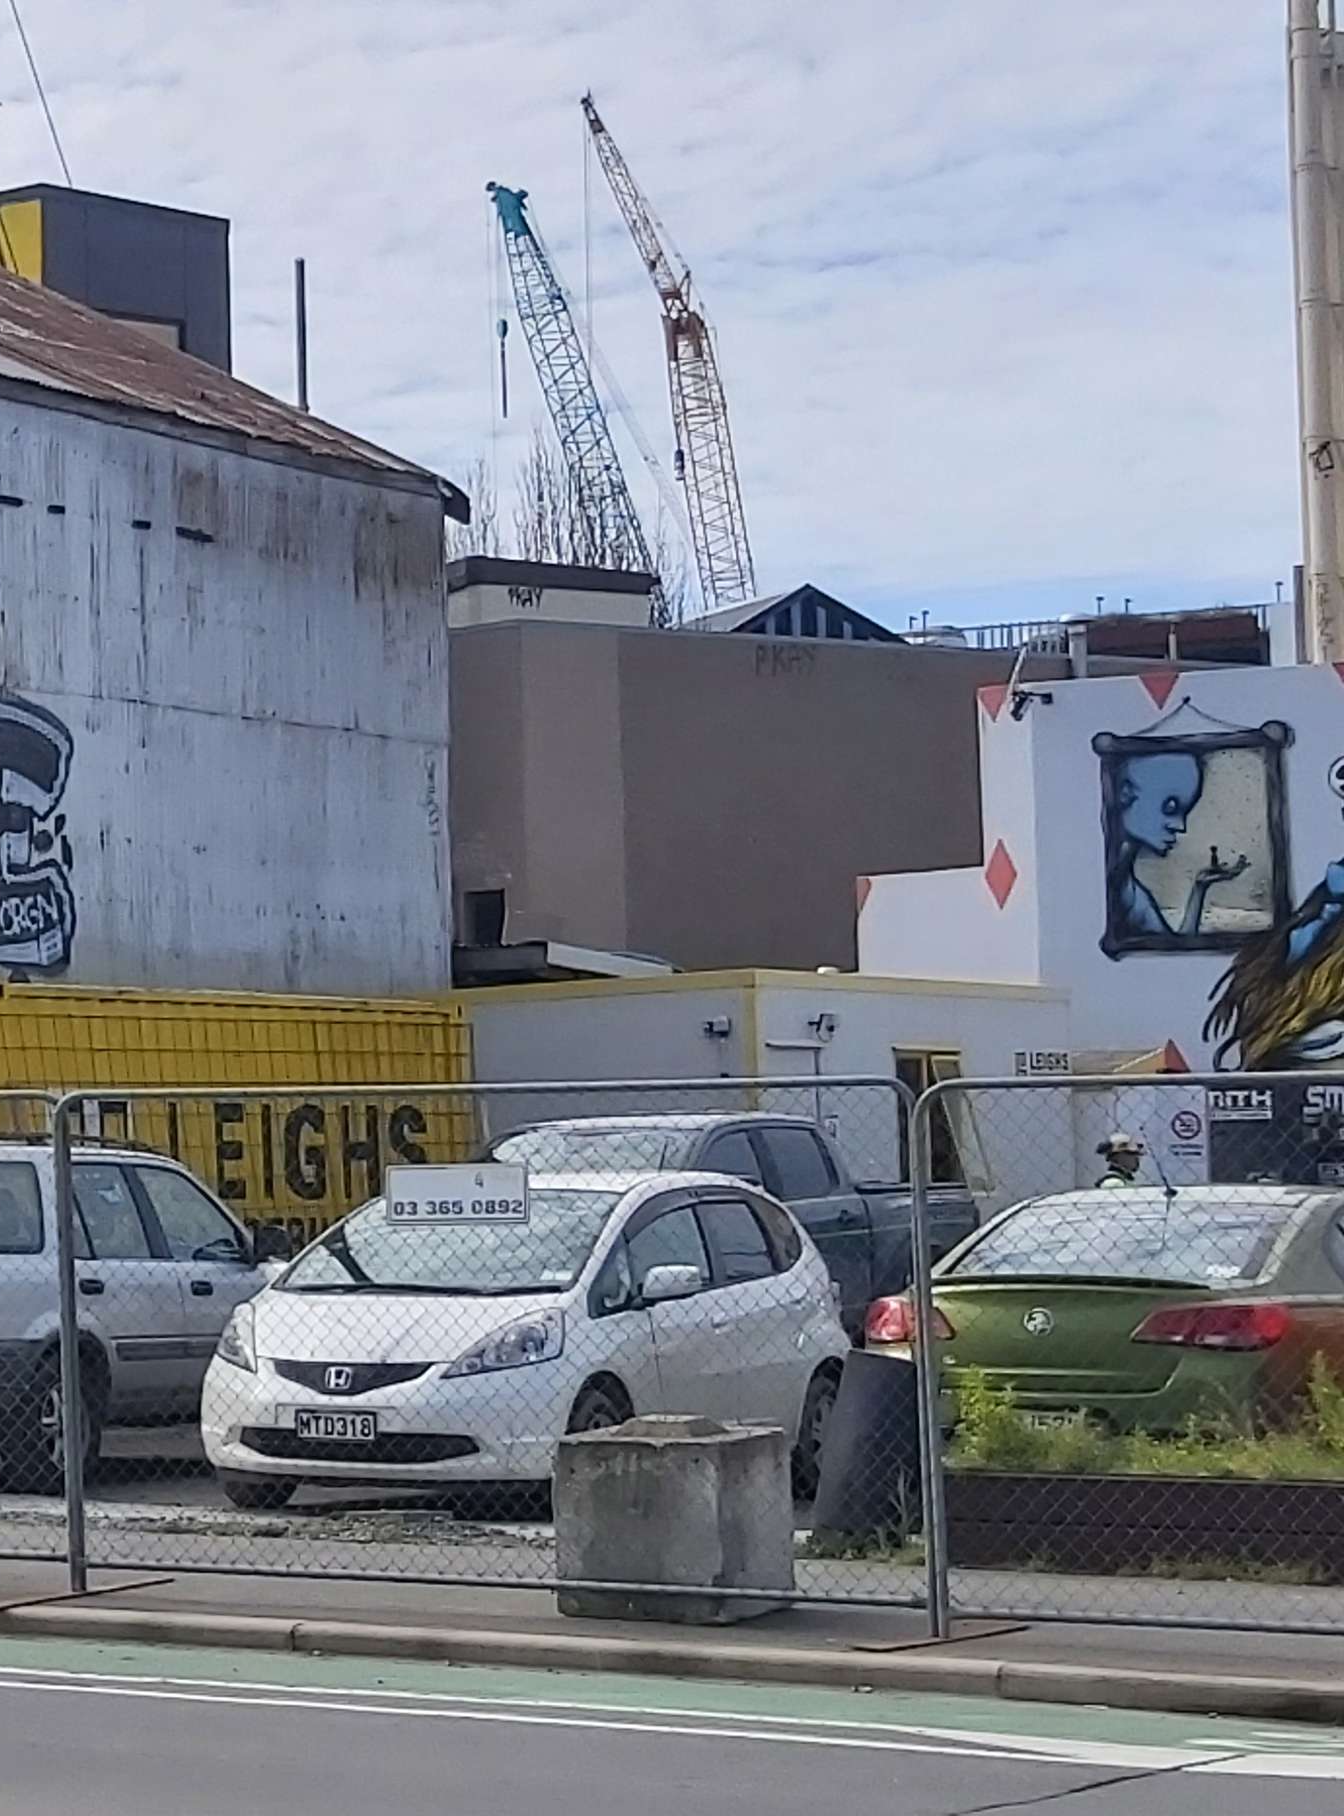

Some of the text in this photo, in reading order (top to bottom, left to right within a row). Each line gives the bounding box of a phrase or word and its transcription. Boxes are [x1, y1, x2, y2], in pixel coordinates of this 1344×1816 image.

[394, 1199, 523, 1216] 03 365 0892
[299, 1415, 372, 1438] MTD318
